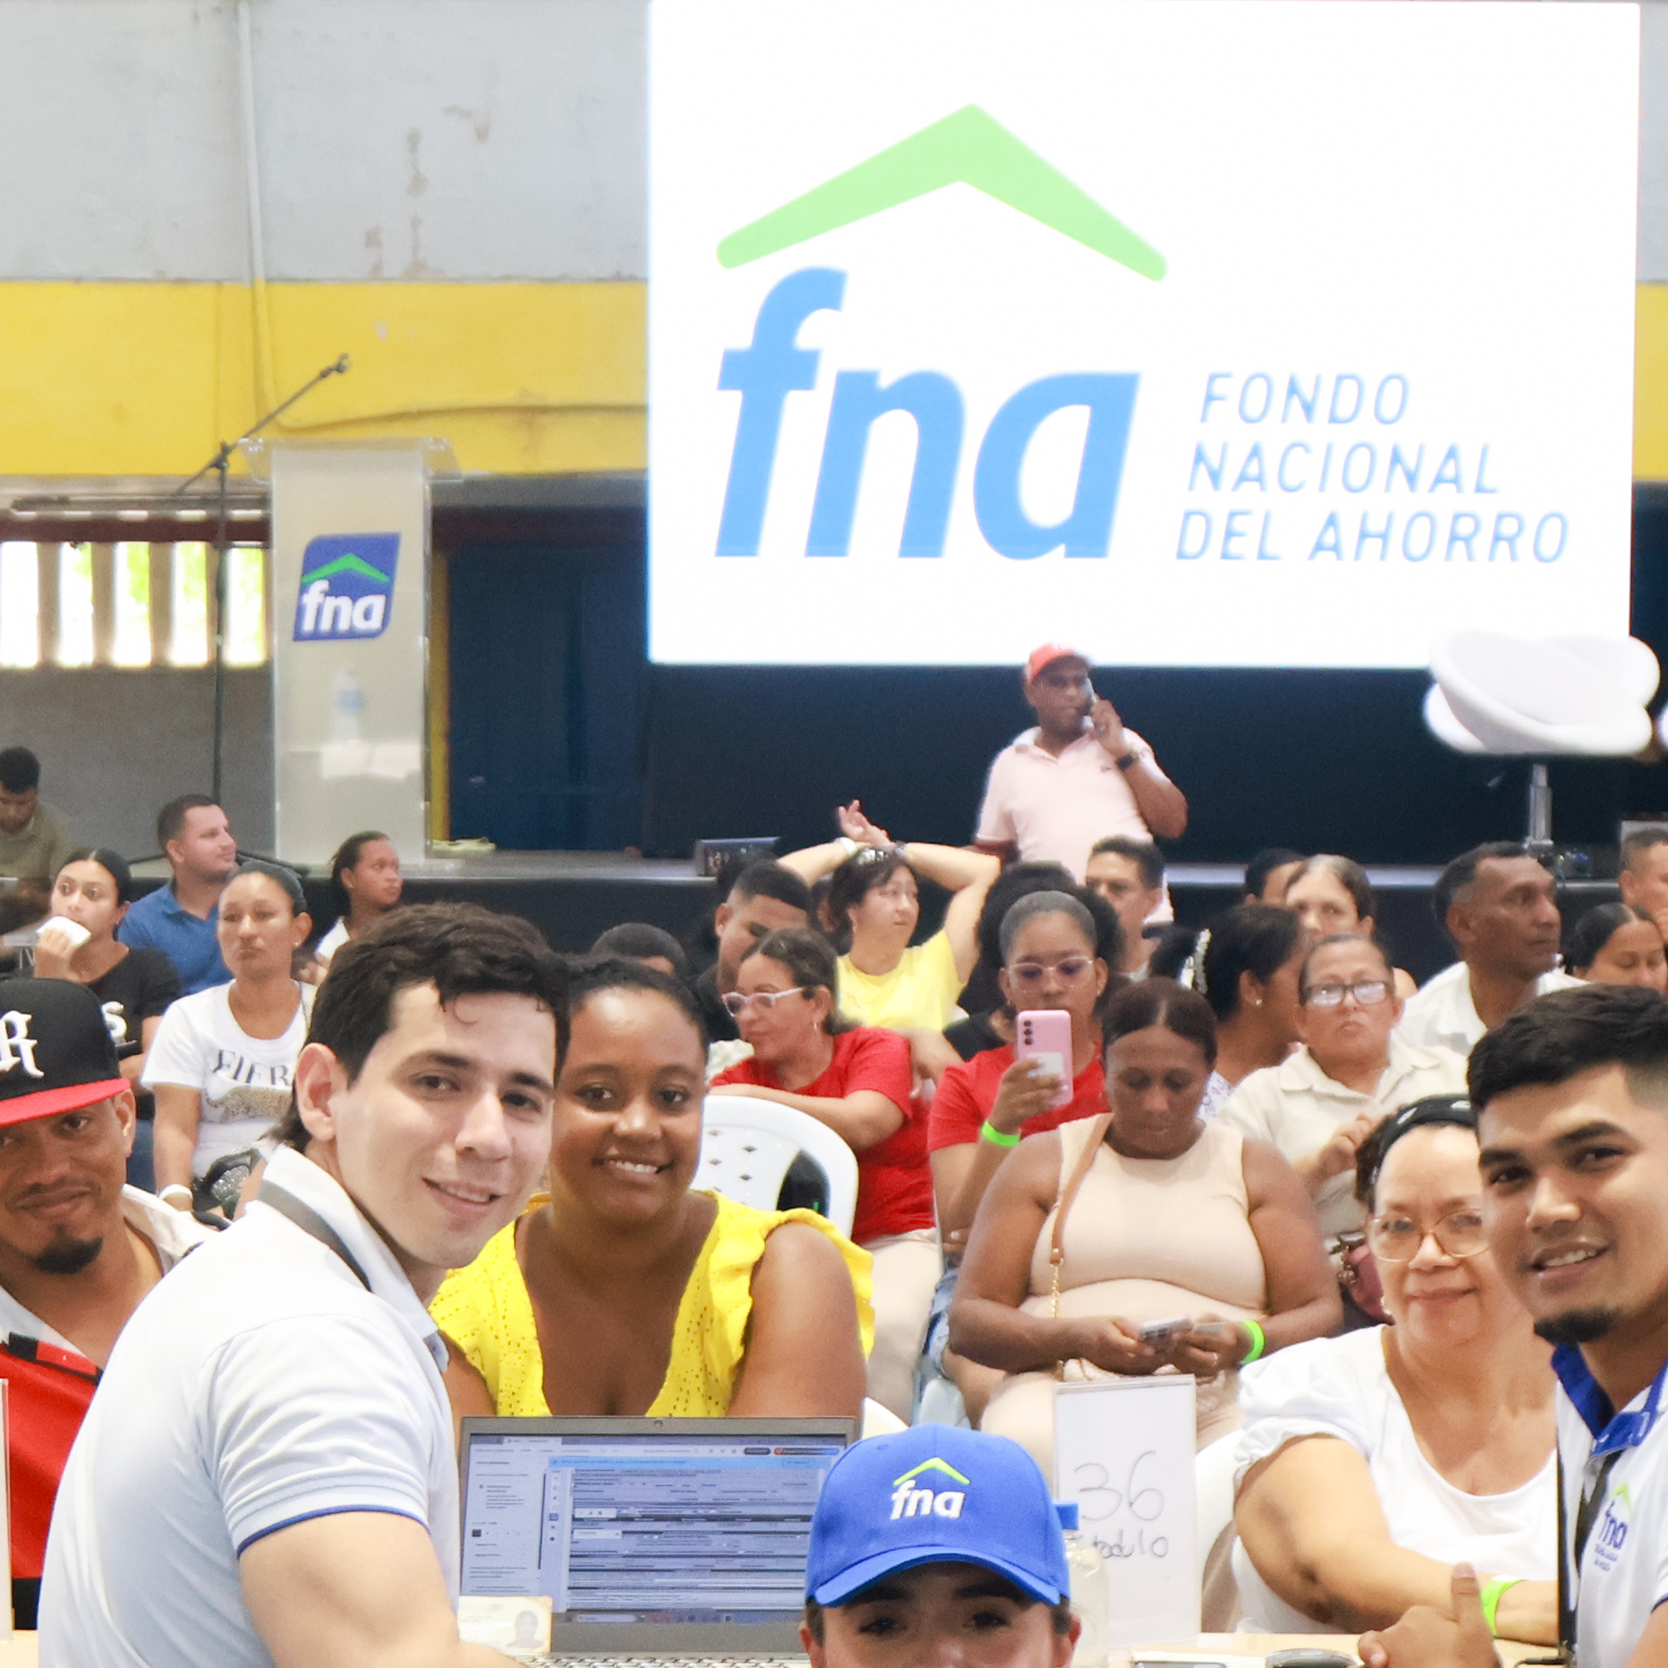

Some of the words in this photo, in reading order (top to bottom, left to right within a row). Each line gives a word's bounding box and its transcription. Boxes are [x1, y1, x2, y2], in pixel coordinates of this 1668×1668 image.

[714, 266, 1141, 561] fna
[1199, 371, 1411, 426] FONDO
[1186, 440, 1501, 495] NACIONAL
[1175, 508, 1284, 562] DEL
[1306, 509, 1571, 564] AHORRO
[301, 578, 387, 633] fna
[889, 1479, 967, 1521] fna
[1073, 1449, 1166, 1522] 36
